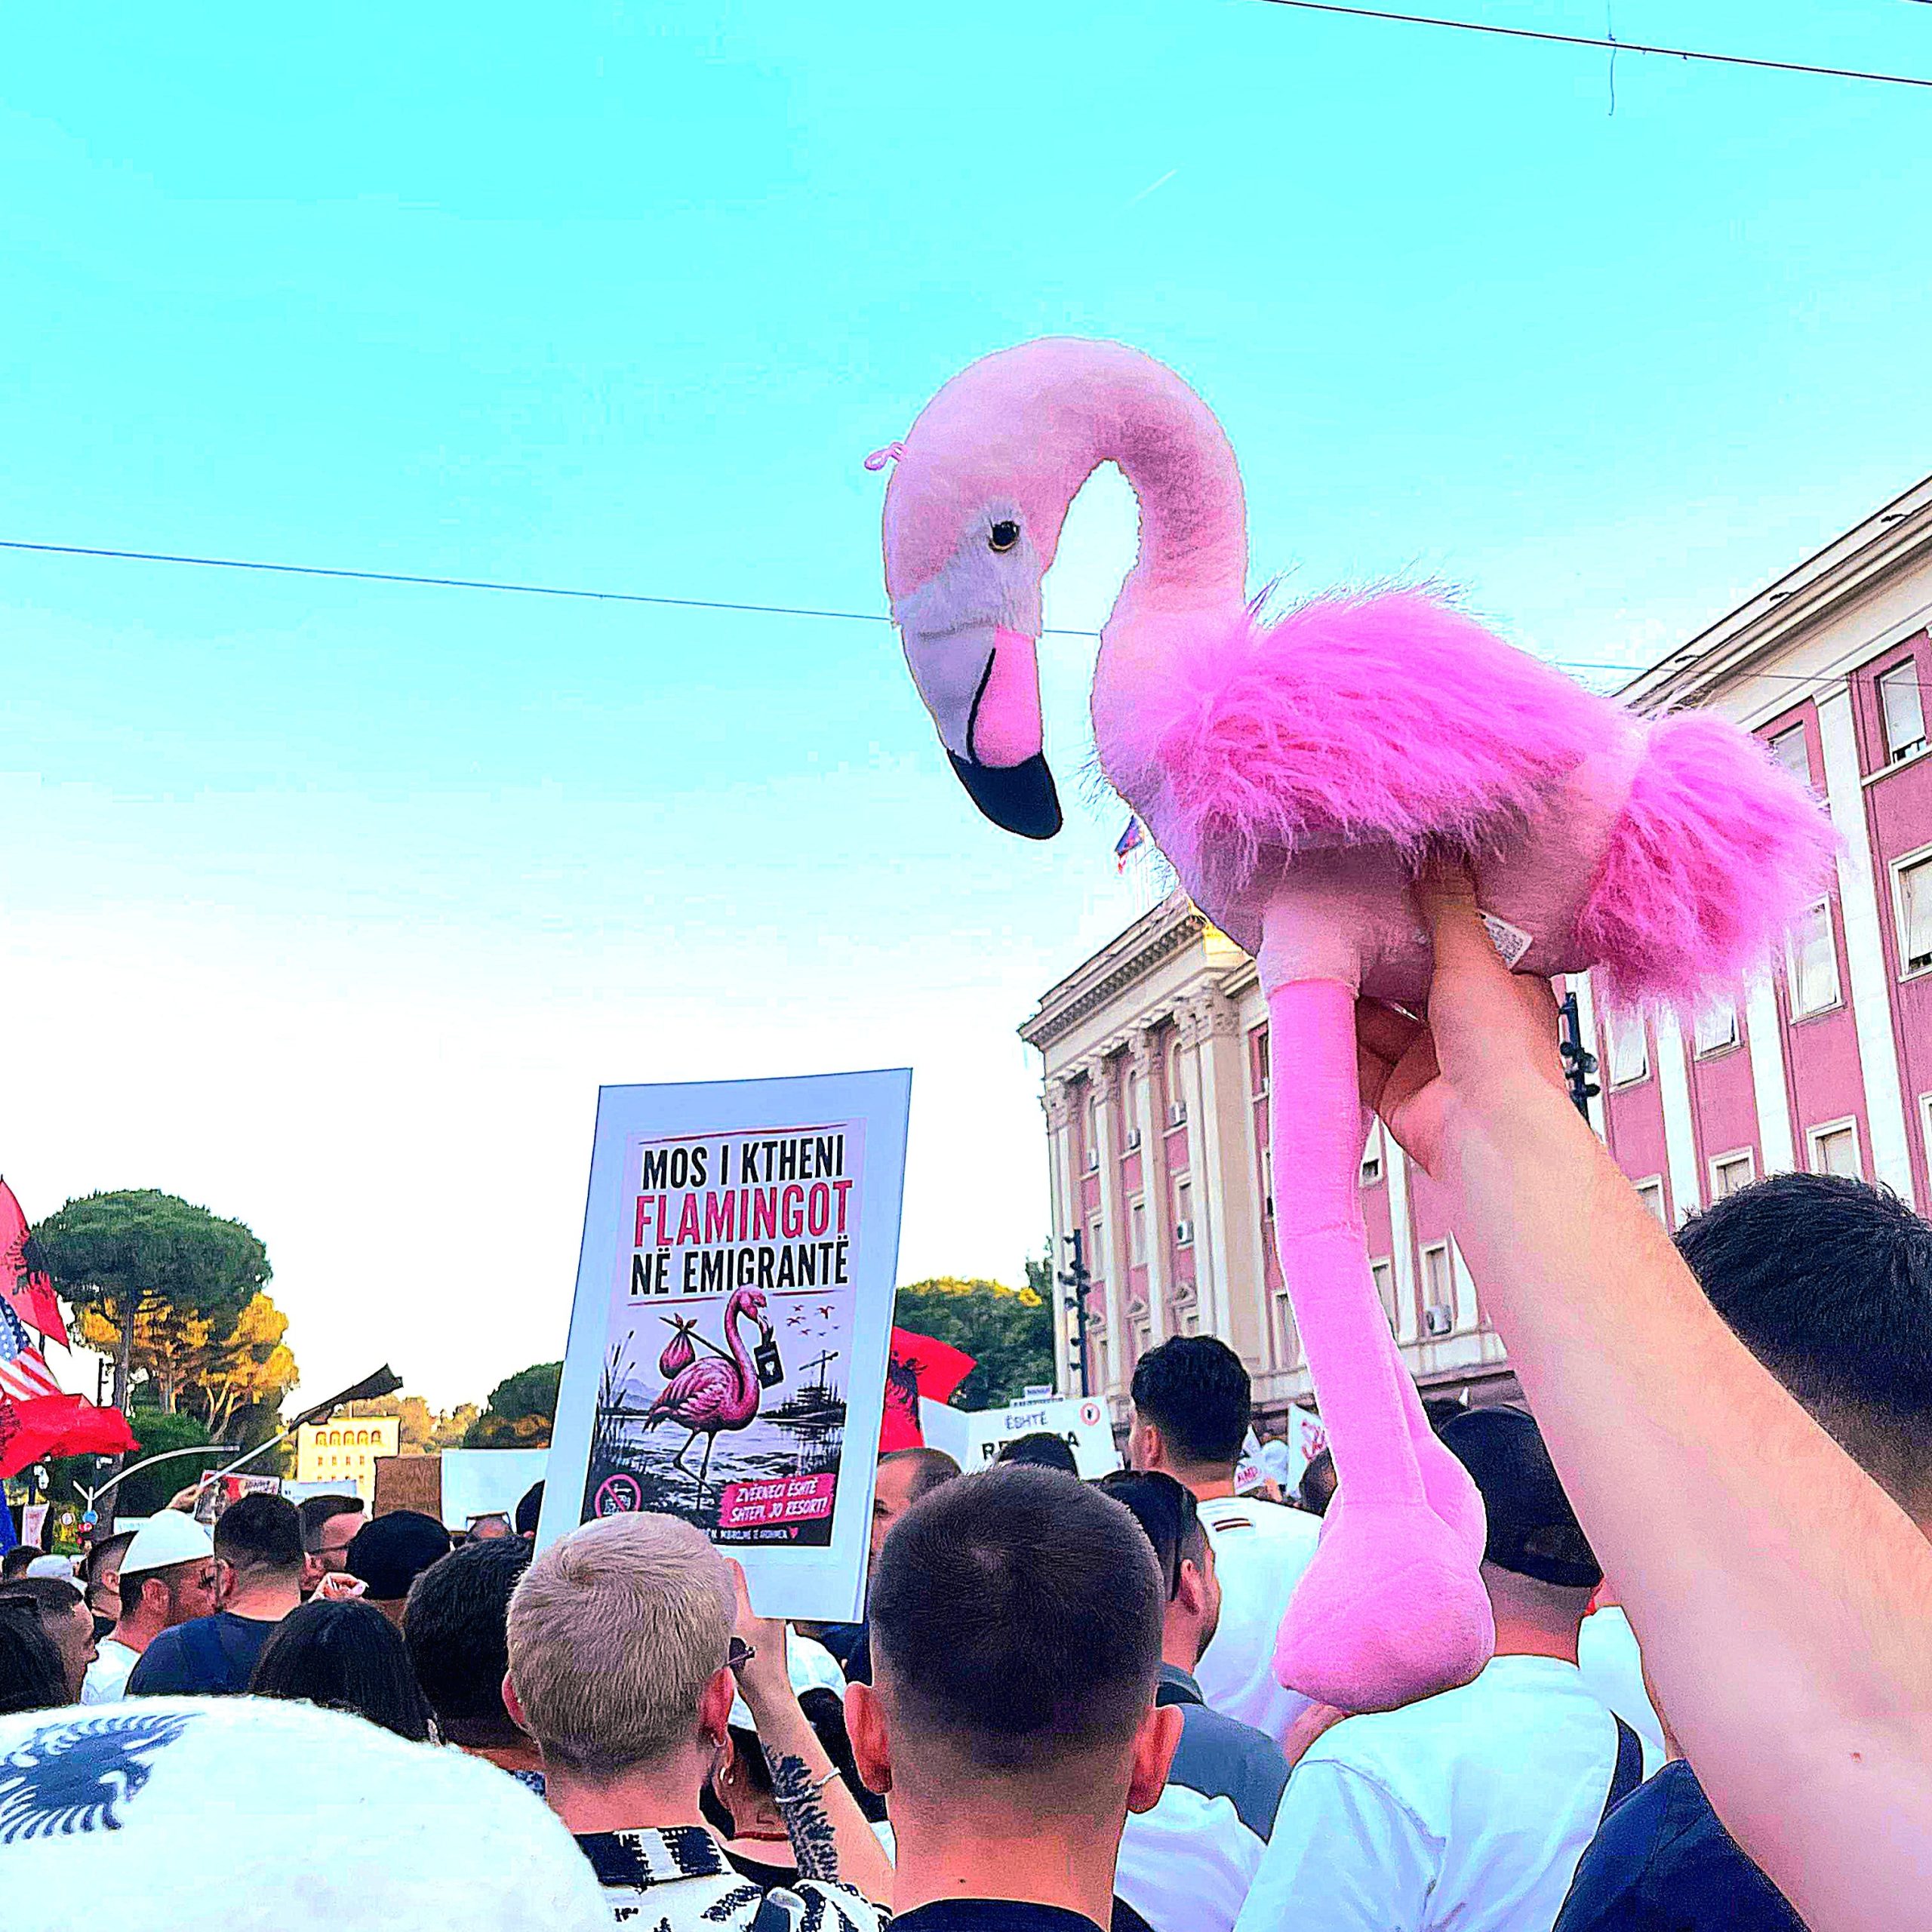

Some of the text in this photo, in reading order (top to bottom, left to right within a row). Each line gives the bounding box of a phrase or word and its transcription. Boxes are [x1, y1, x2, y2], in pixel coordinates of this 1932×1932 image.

[643, 1134, 844, 1190] MOS I KTHENI
[635, 1180, 853, 1247] FLAMINGOT
[630, 1235, 849, 1296] NË EMIGRANTË
[1005, 1410, 1048, 1430] ËSHTË
[788, 1477, 818, 1497] ËSHTË
[768, 1502, 783, 1518] JO
[786, 1497, 828, 1515] RESORT!
